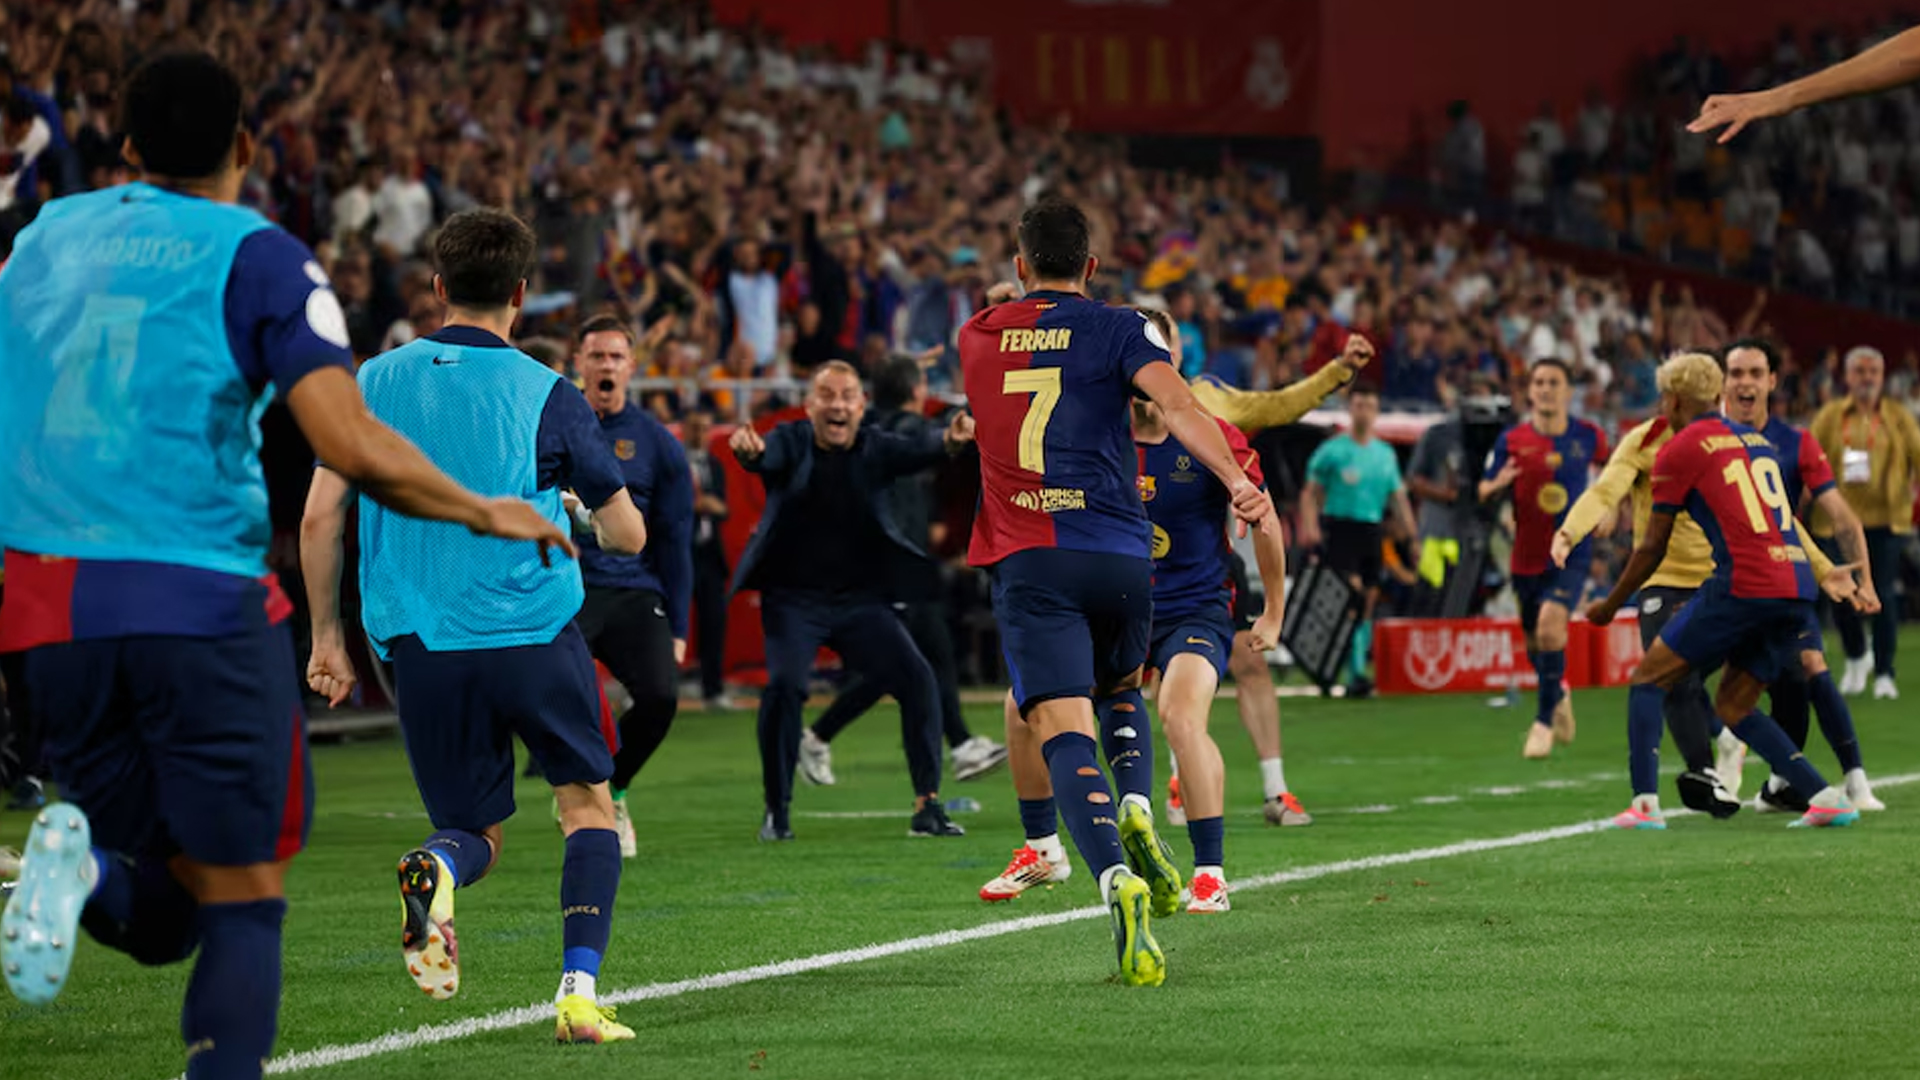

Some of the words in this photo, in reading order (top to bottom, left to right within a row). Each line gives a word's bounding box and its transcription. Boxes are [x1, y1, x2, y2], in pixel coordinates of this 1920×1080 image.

[1036, 32, 1203, 105] FINAL
[999, 328, 1072, 352] FERRAN
[1002, 366, 1062, 475] 7
[1722, 456, 1793, 534] 19
[1455, 629, 1514, 671] COPA
